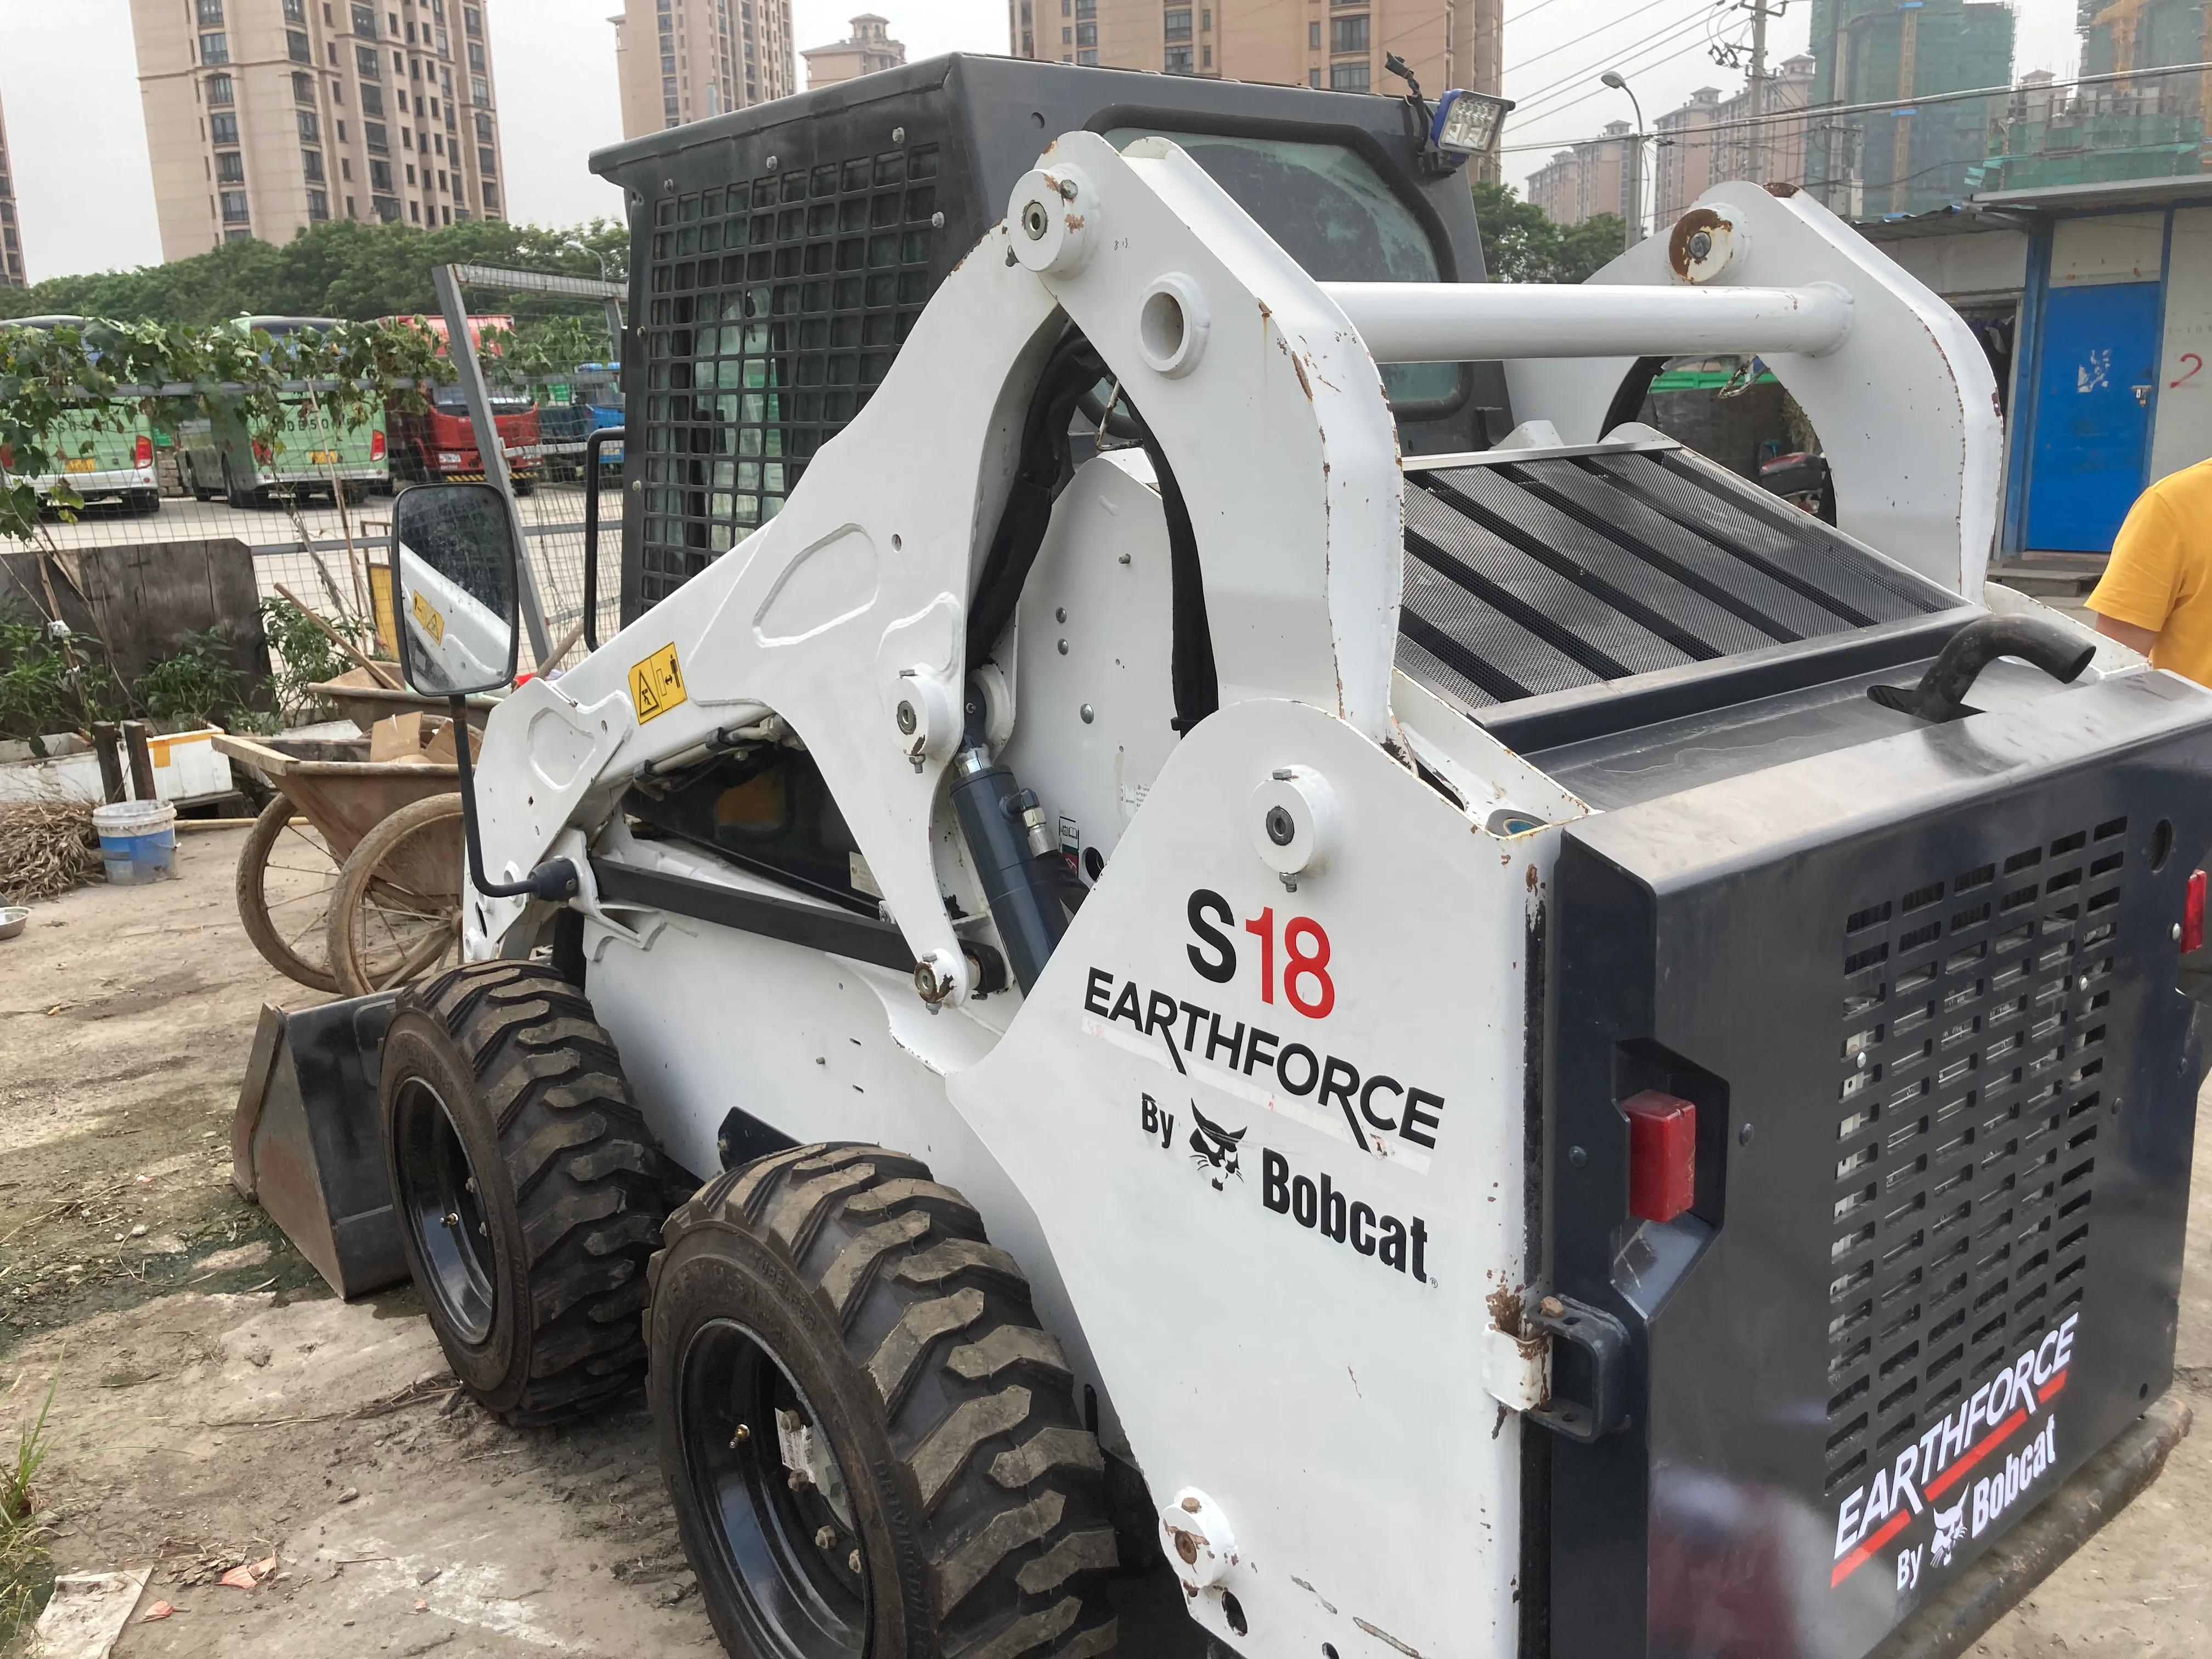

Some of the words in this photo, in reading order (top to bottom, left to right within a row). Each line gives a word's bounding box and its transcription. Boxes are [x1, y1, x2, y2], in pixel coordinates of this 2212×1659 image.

[2169, 353, 2204, 389] 2
[1187, 888, 1335, 1019] S18
[1084, 966, 1445, 1152] EARTHFORCE
[1142, 1092, 1173, 1148] By
[1833, 1312, 2078, 1560] EARTHFORCE
[1897, 1543, 1923, 1591] By
[1971, 1414, 2056, 1539] Bobcat
